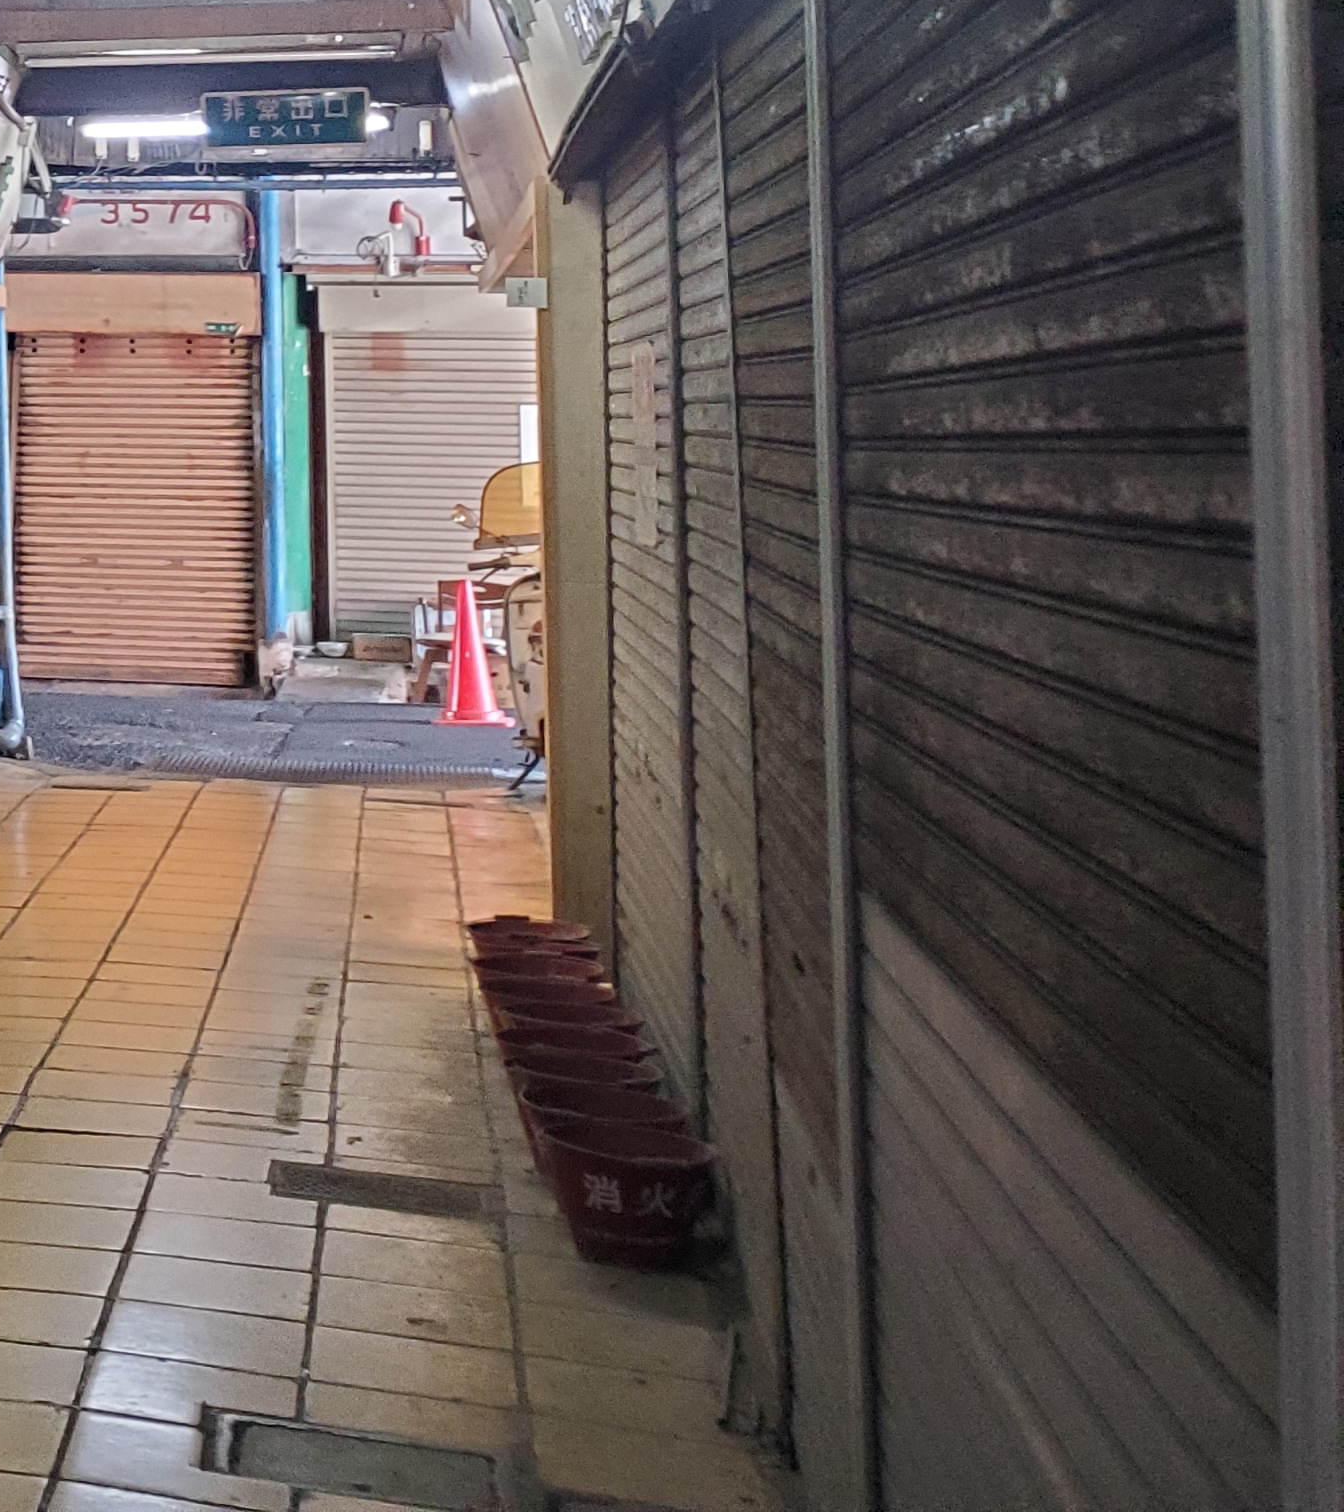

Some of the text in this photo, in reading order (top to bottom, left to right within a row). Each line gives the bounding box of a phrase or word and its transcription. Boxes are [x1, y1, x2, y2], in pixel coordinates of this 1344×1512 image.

[223, 95, 348, 121] 非常出口
[249, 124, 322, 138] EXIT
[100, 198, 212, 225] 3574
[582, 1172, 673, 1220] 消火
